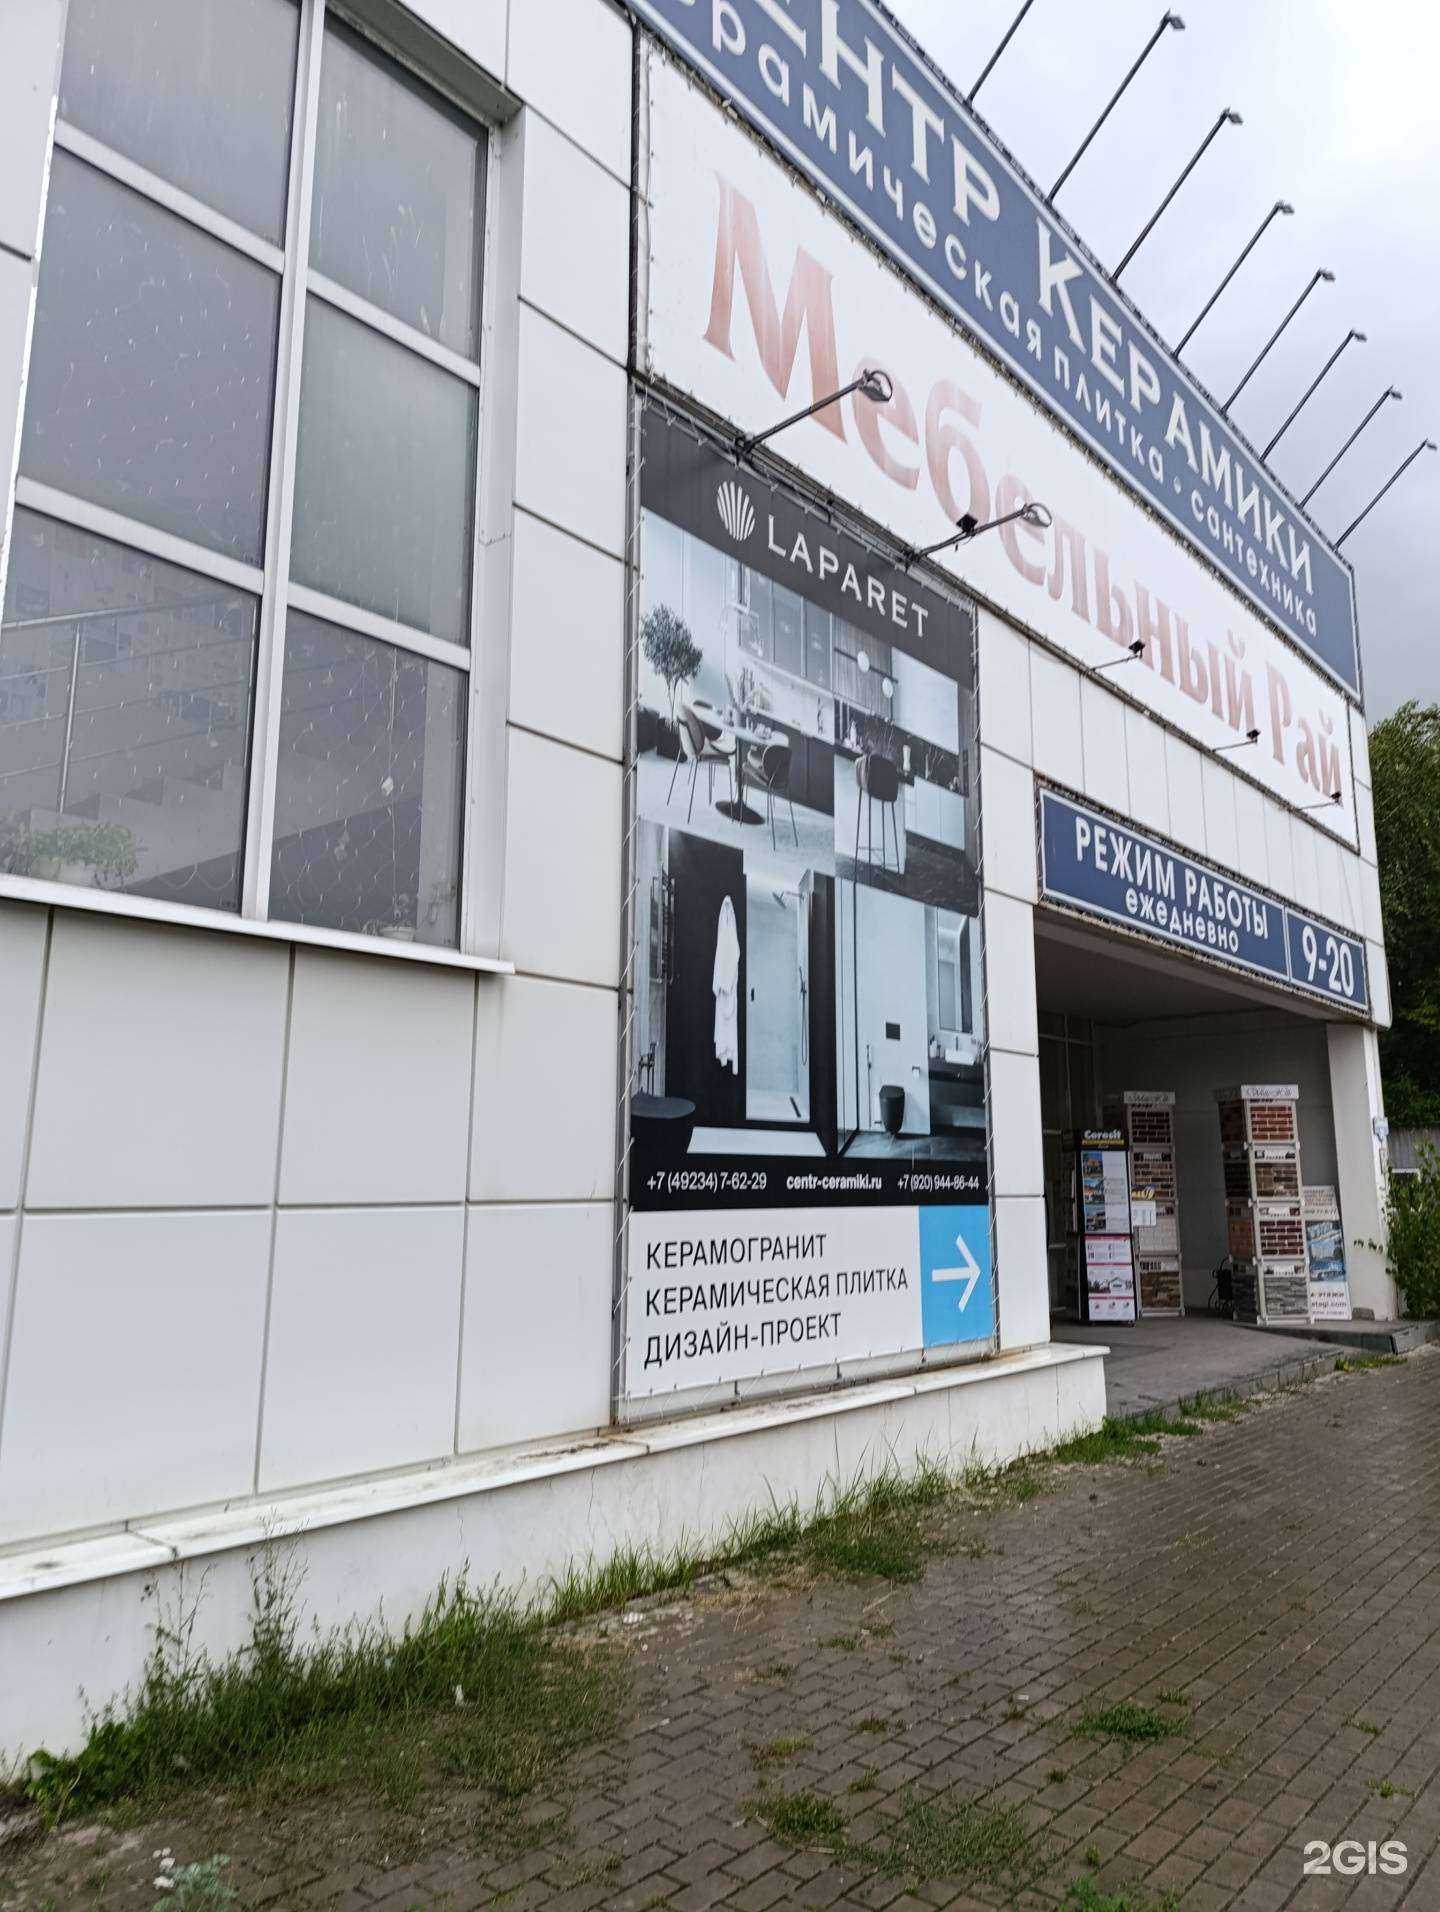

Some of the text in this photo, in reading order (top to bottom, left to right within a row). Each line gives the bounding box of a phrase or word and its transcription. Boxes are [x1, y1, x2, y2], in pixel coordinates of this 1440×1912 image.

[679, 0, 1317, 638] рамическая плитка сантехника
[1036, 217, 1316, 596] КЕРАМИКИ
[702, 170, 1343, 798] Мебельный Рай
[767, 513, 930, 638] LAPARET
[1074, 816, 1269, 940] РЕЖИМ РАБОТЫ
[1125, 887, 1240, 954] ежедневно
[1301, 924, 1355, 998] 9-20
[646, 1171, 768, 1193] +7 (49234) 7-62-29
[786, 1172, 883, 1191] centr-ceramiki.ru
[896, 1174, 909, 1191] +7
[910, 1174, 934, 1193] (920)
[646, 1232, 828, 1271] КЕРАМОГРАНИТ
[645, 1266, 909, 1317] КЕРАМИЧЕСКАЯ ПЛИТКА
[643, 1312, 842, 1371] ДИЗАЙН-ПРОЕКТ
